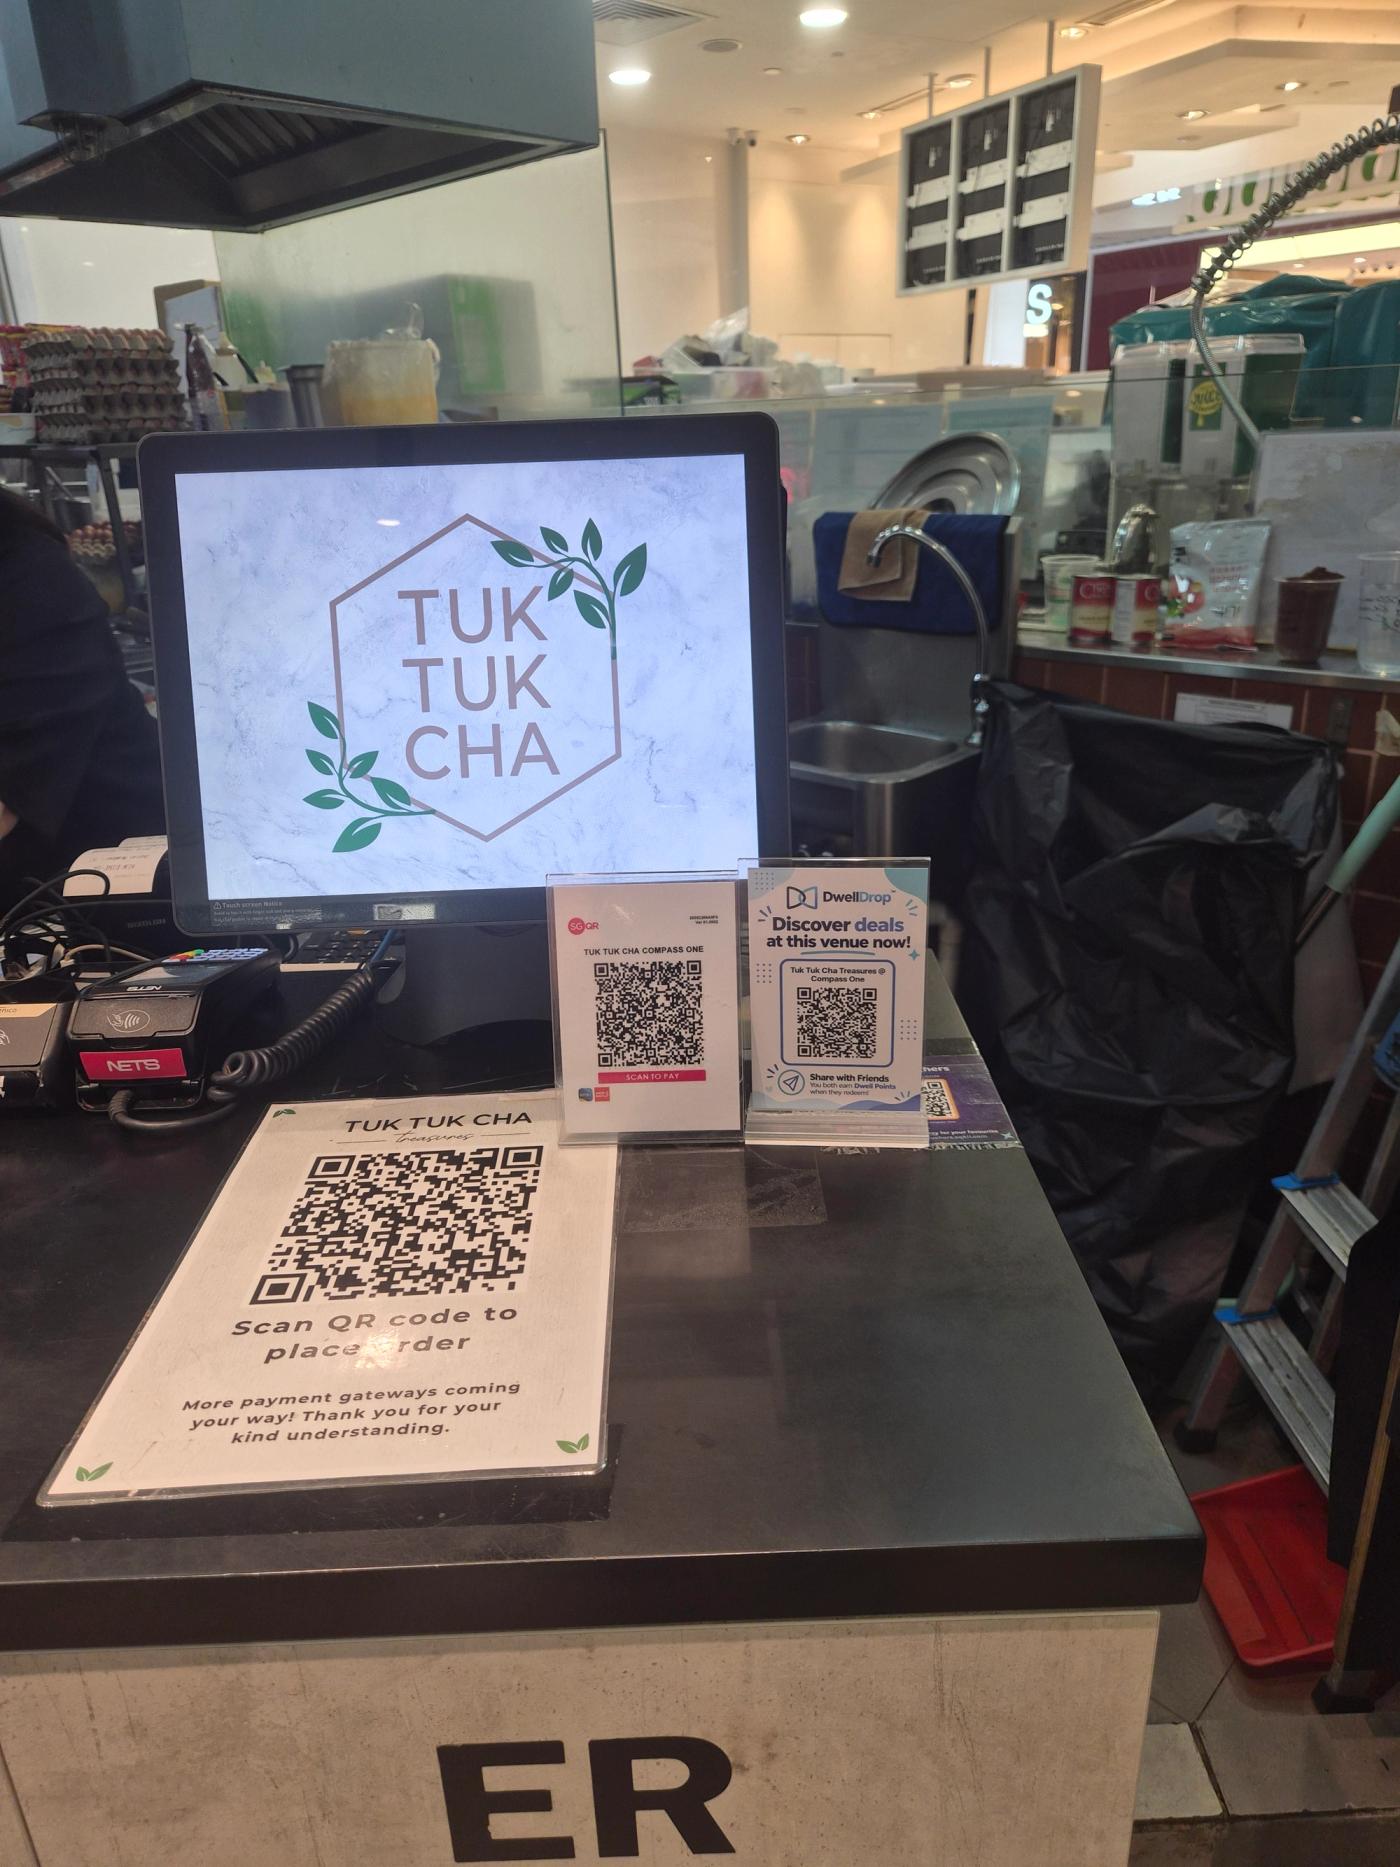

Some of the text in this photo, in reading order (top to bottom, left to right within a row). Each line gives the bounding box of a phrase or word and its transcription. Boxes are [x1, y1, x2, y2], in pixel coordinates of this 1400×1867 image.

[398, 585, 548, 645] TUK
[402, 654, 552, 713] TUK
[405, 722, 561, 780] CHA
[772, 916, 904, 932] Discover deals
[766, 934, 911, 948] at this venue now!
[811, 975, 847, 983] Compass
[106, 1058, 161, 1073] NETS
[810, 1073, 889, 1082] Share with Friends
[346, 1112, 533, 1133] TUK TUK CHA
[231, 1307, 517, 1335] Scan QR code to
[263, 1336, 471, 1364] place rder
[182, 1382, 521, 1411] More payment gateways coming
[189, 1400, 502, 1431] your way! Thank you for your
[231, 1422, 450, 1444] kind understanding.
[437, 1736, 736, 1862] ER
